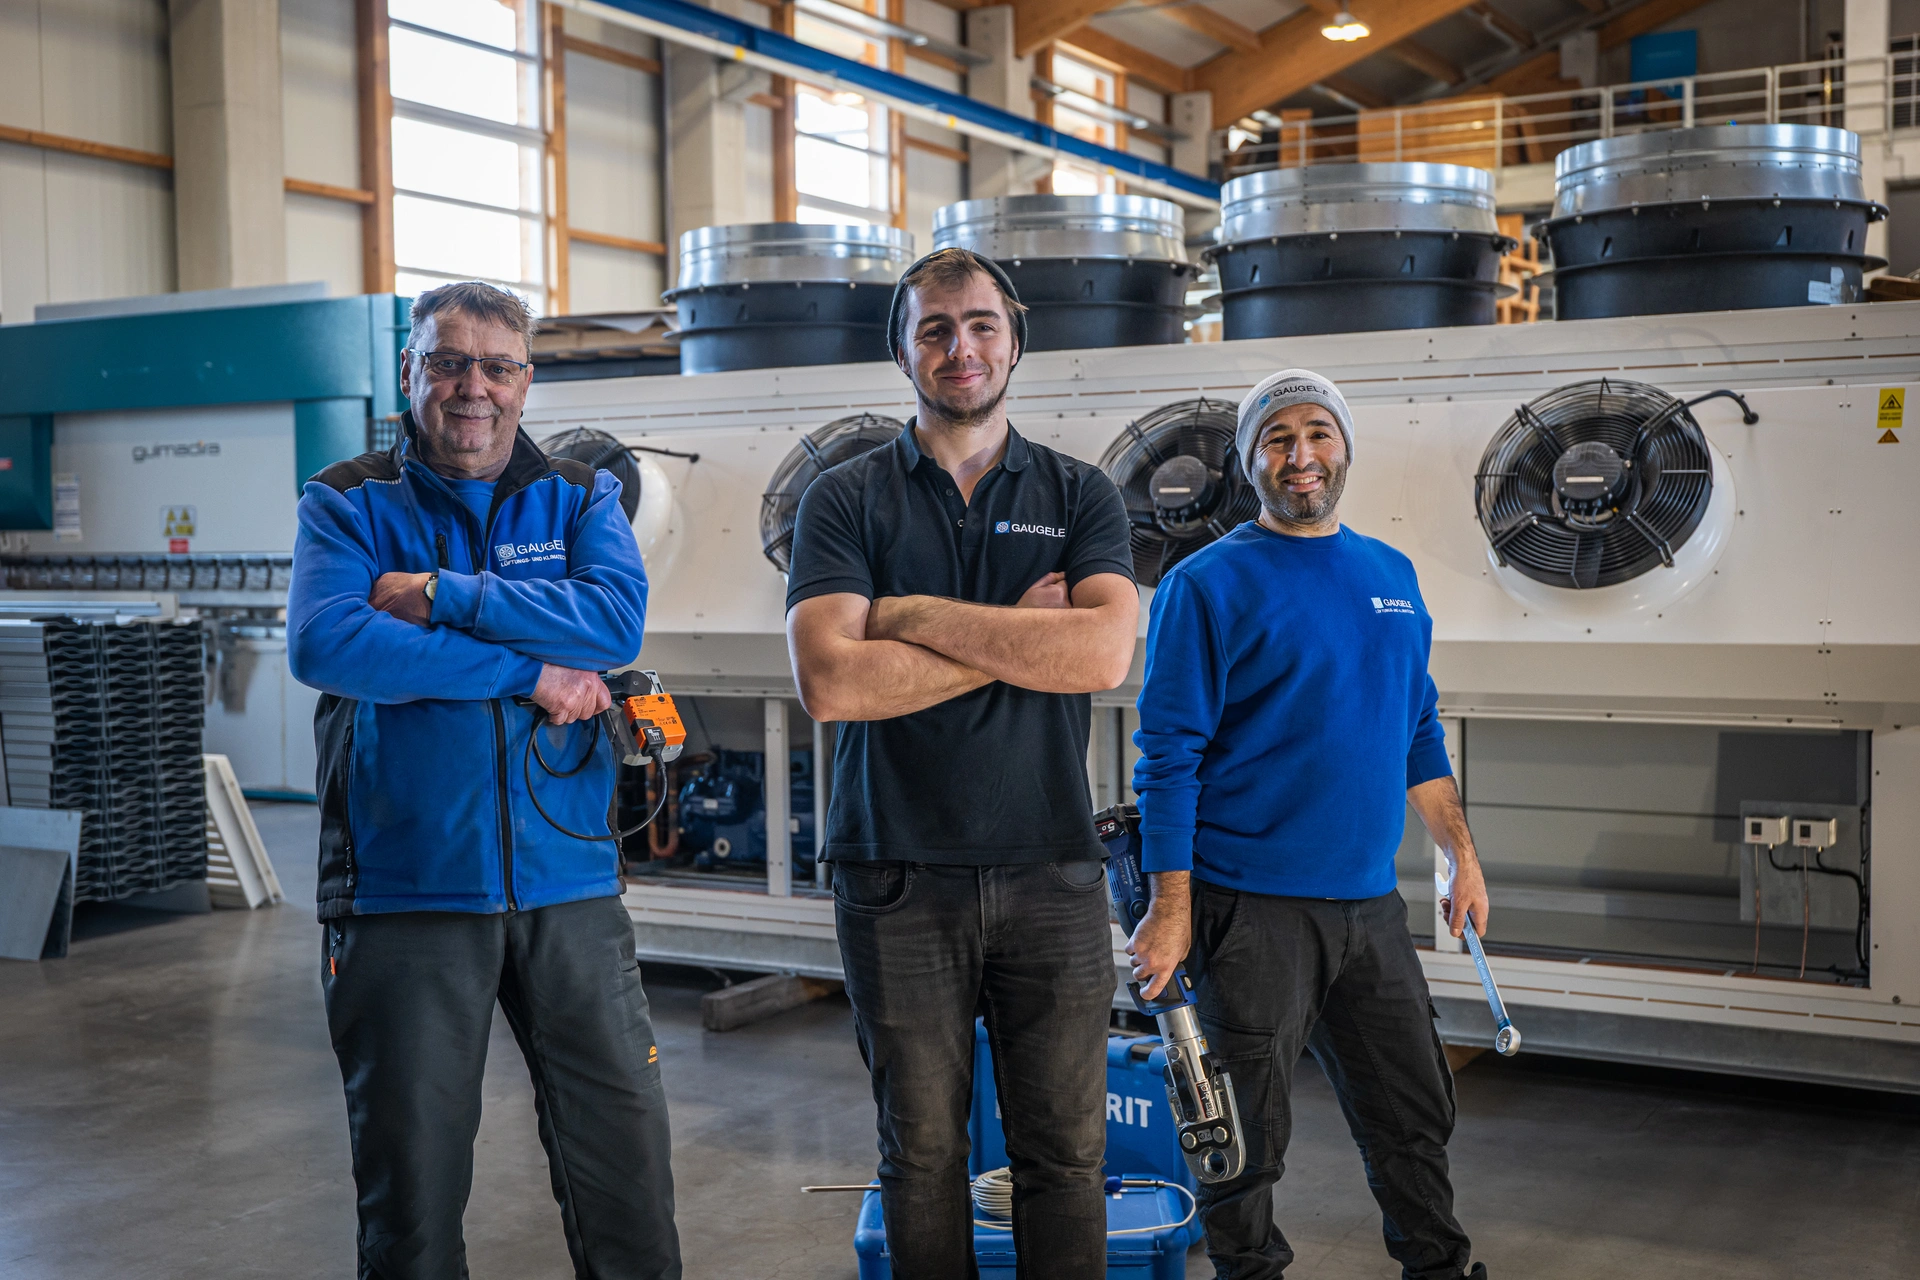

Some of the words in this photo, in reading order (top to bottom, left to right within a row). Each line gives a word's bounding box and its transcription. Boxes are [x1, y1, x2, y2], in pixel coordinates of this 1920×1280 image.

[1011, 523, 1066, 538] GAUGELE
[516, 539, 566, 555] GAUGEL
[1106, 1092, 1153, 1128] RIT
